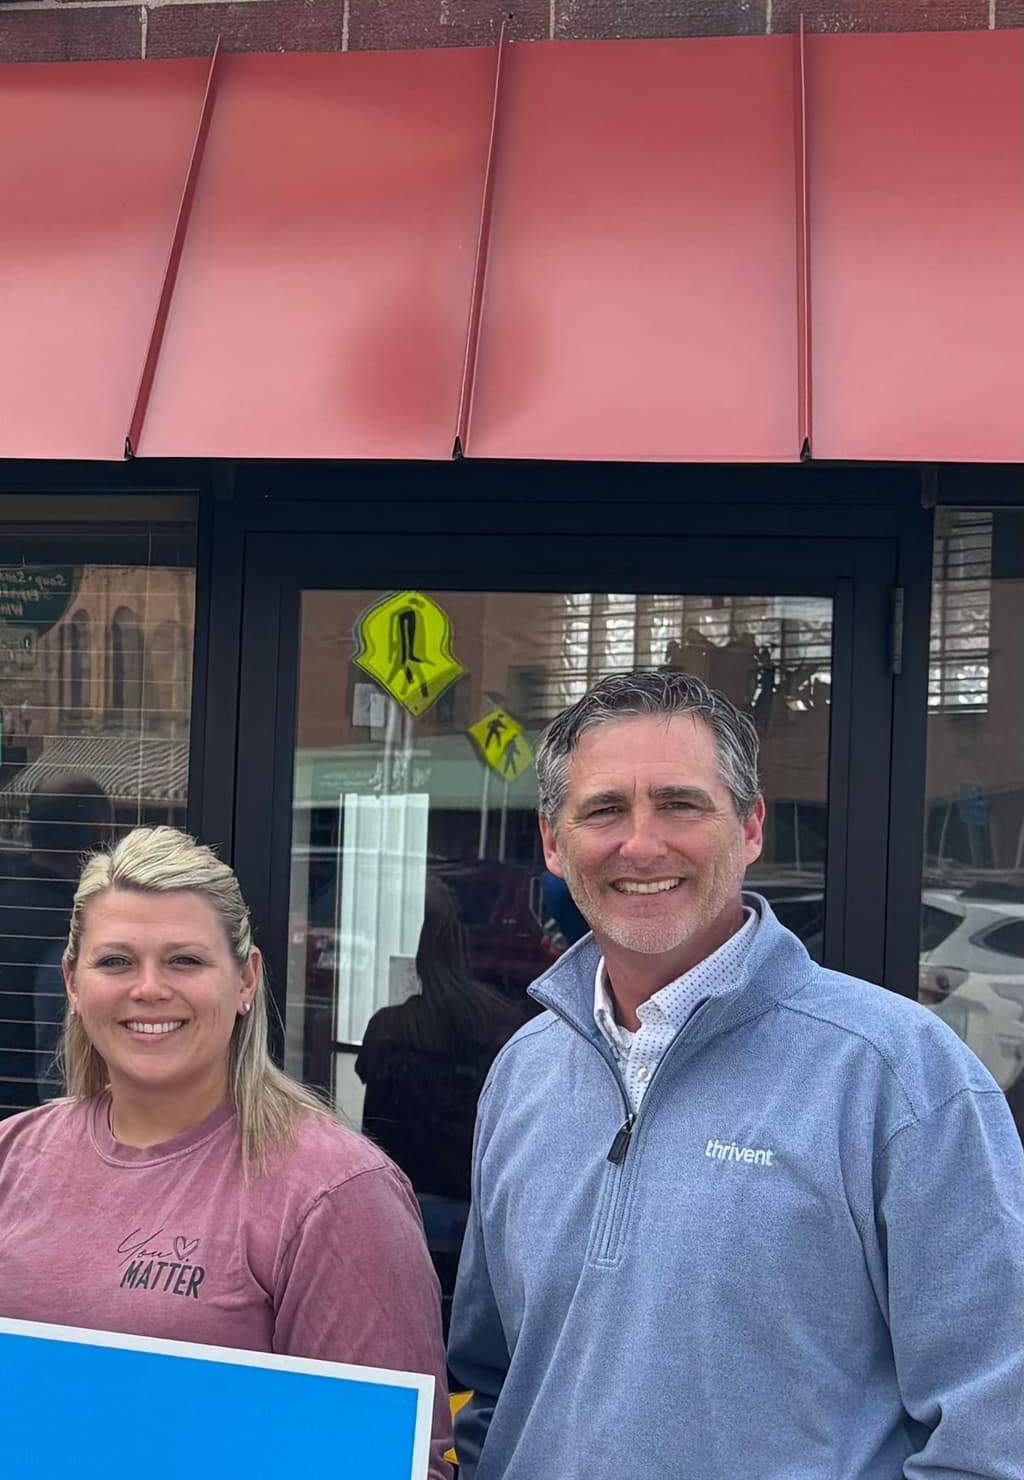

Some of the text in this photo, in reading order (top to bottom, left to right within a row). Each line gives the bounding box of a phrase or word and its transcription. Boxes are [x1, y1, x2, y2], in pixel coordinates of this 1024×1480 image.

[705, 1139, 774, 1166] thrivent
[117, 1228, 173, 1268] You
[119, 1259, 206, 1299] MATTER
